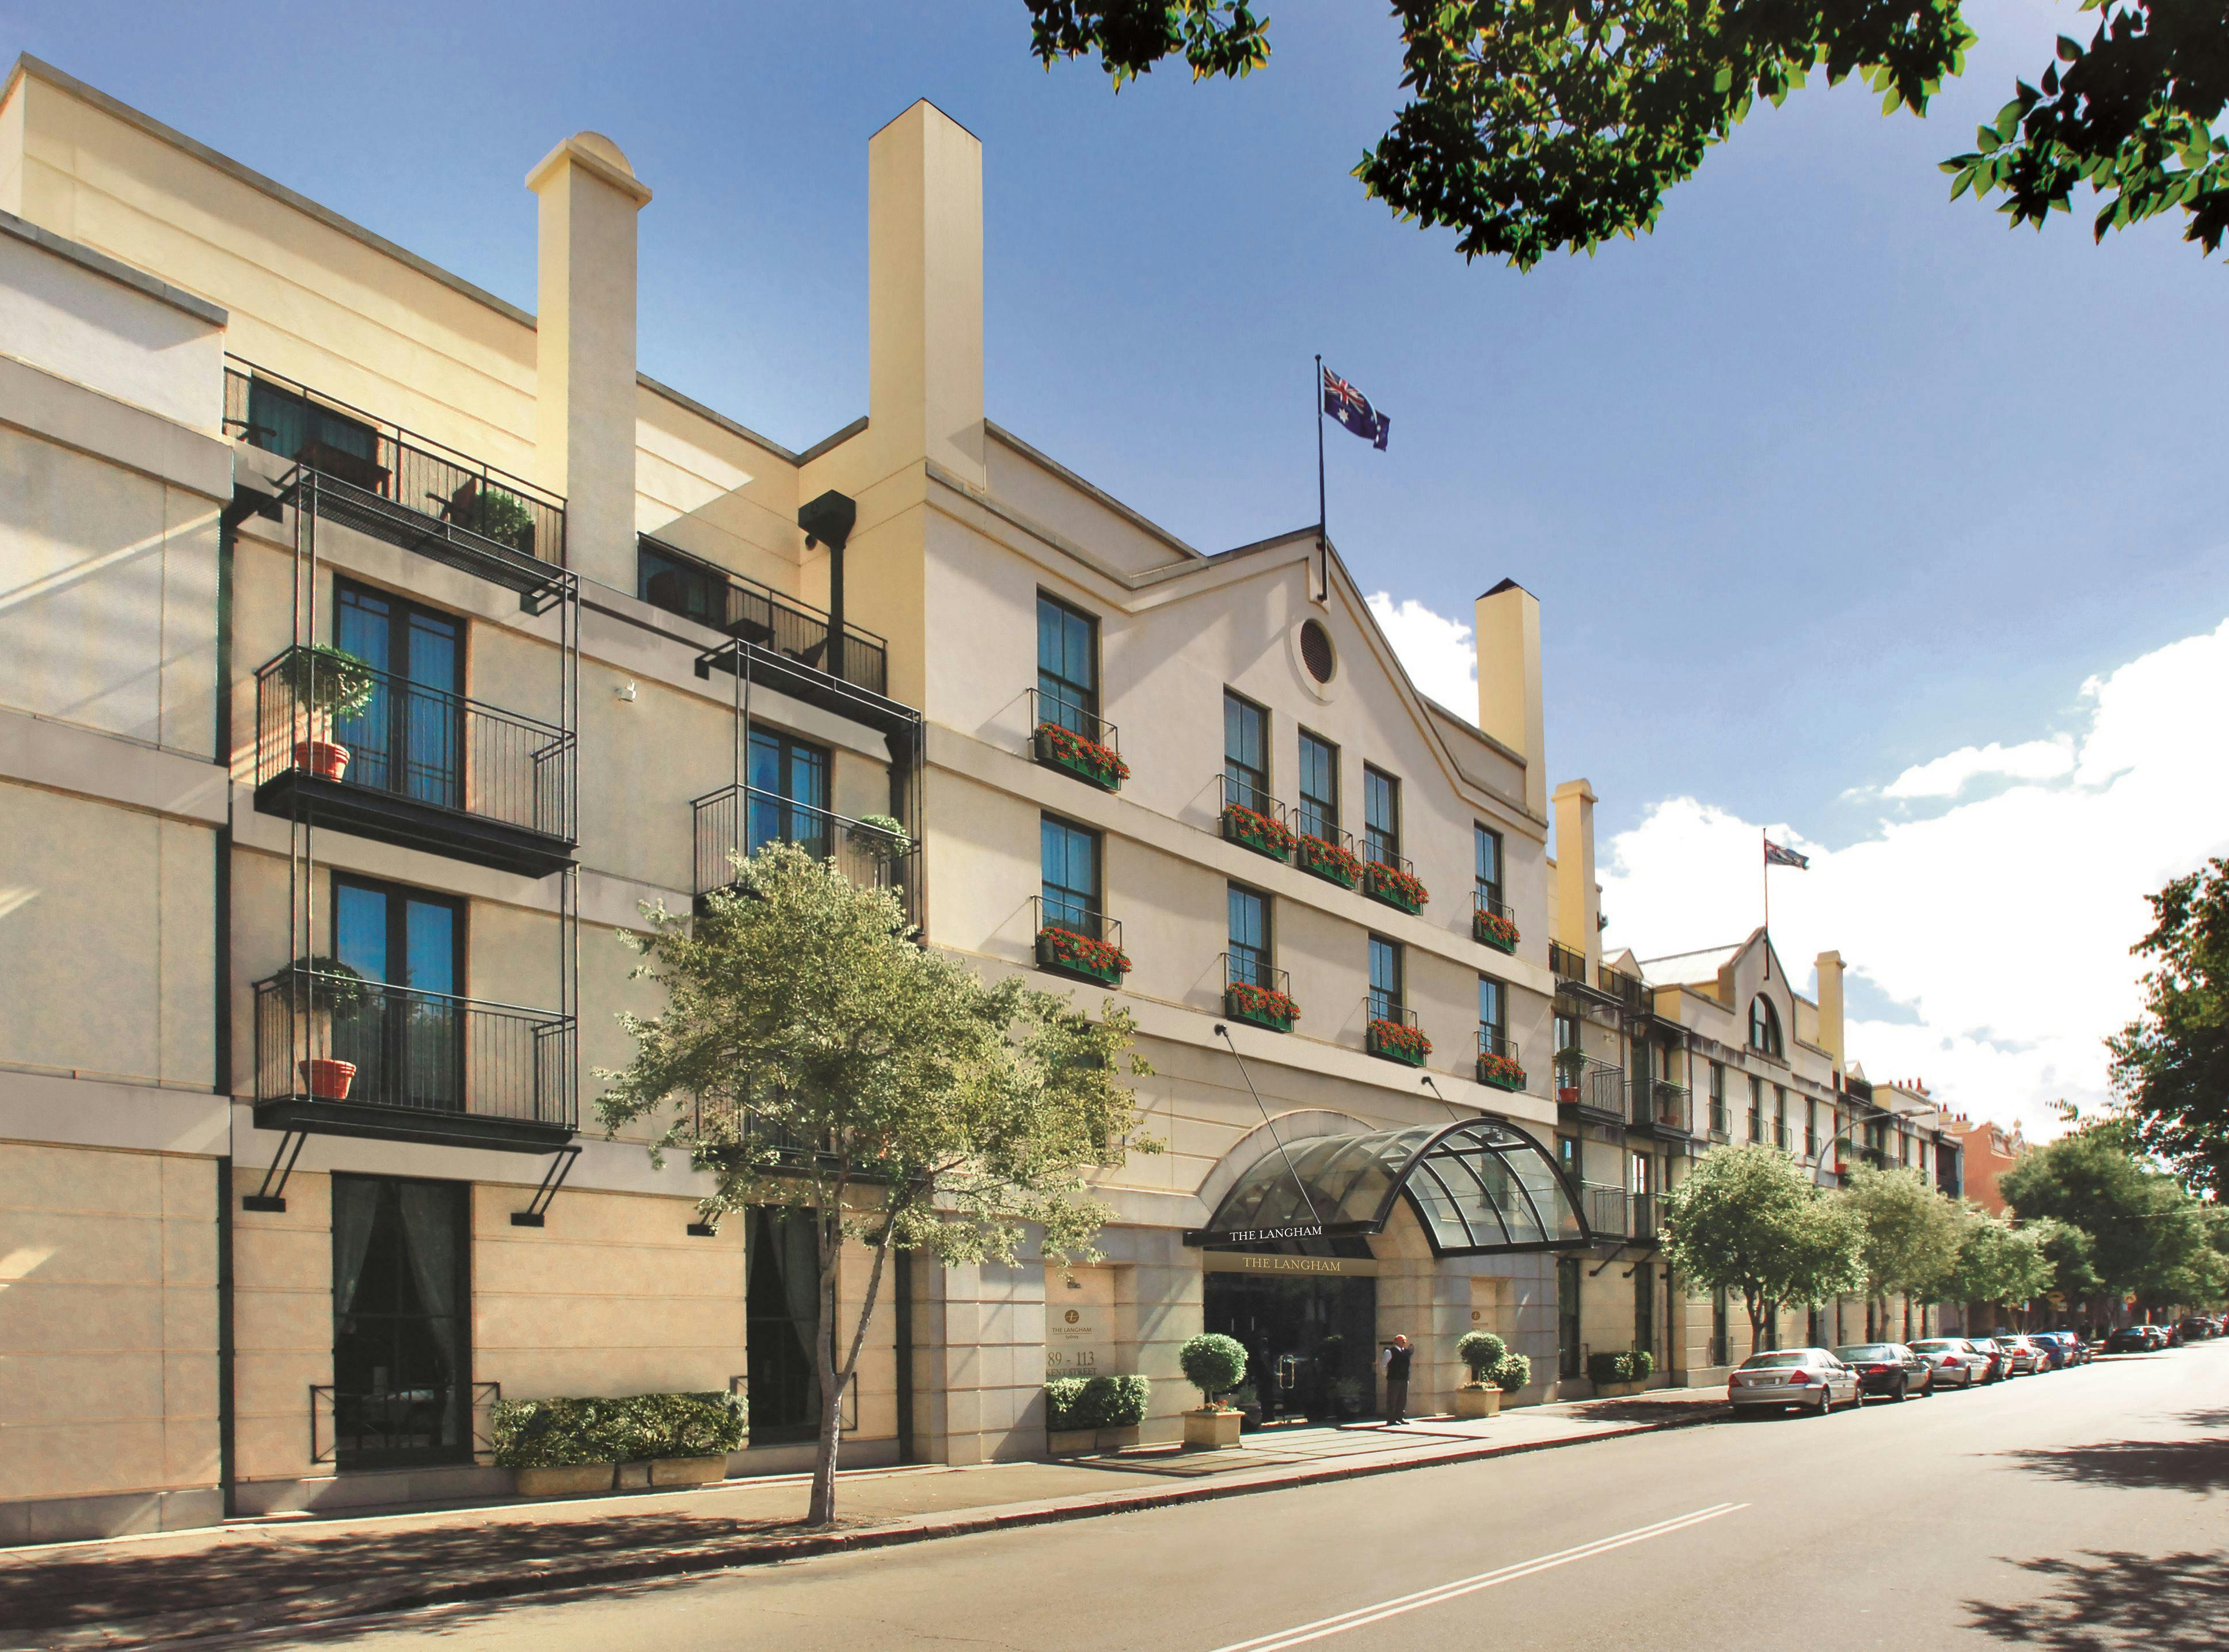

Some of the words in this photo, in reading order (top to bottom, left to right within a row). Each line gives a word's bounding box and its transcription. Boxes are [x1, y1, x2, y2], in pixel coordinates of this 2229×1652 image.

[1230, 1231, 1256, 1241] THE
[1259, 1225, 1322, 1239] LANGHAM
[1242, 1257, 1271, 1268] THE
[1274, 1259, 1341, 1272] LANGHAM
[1048, 1352, 1062, 1366] 89
[1077, 1351, 1094, 1365] 113
[1068, 1368, 1097, 1376] STREET
